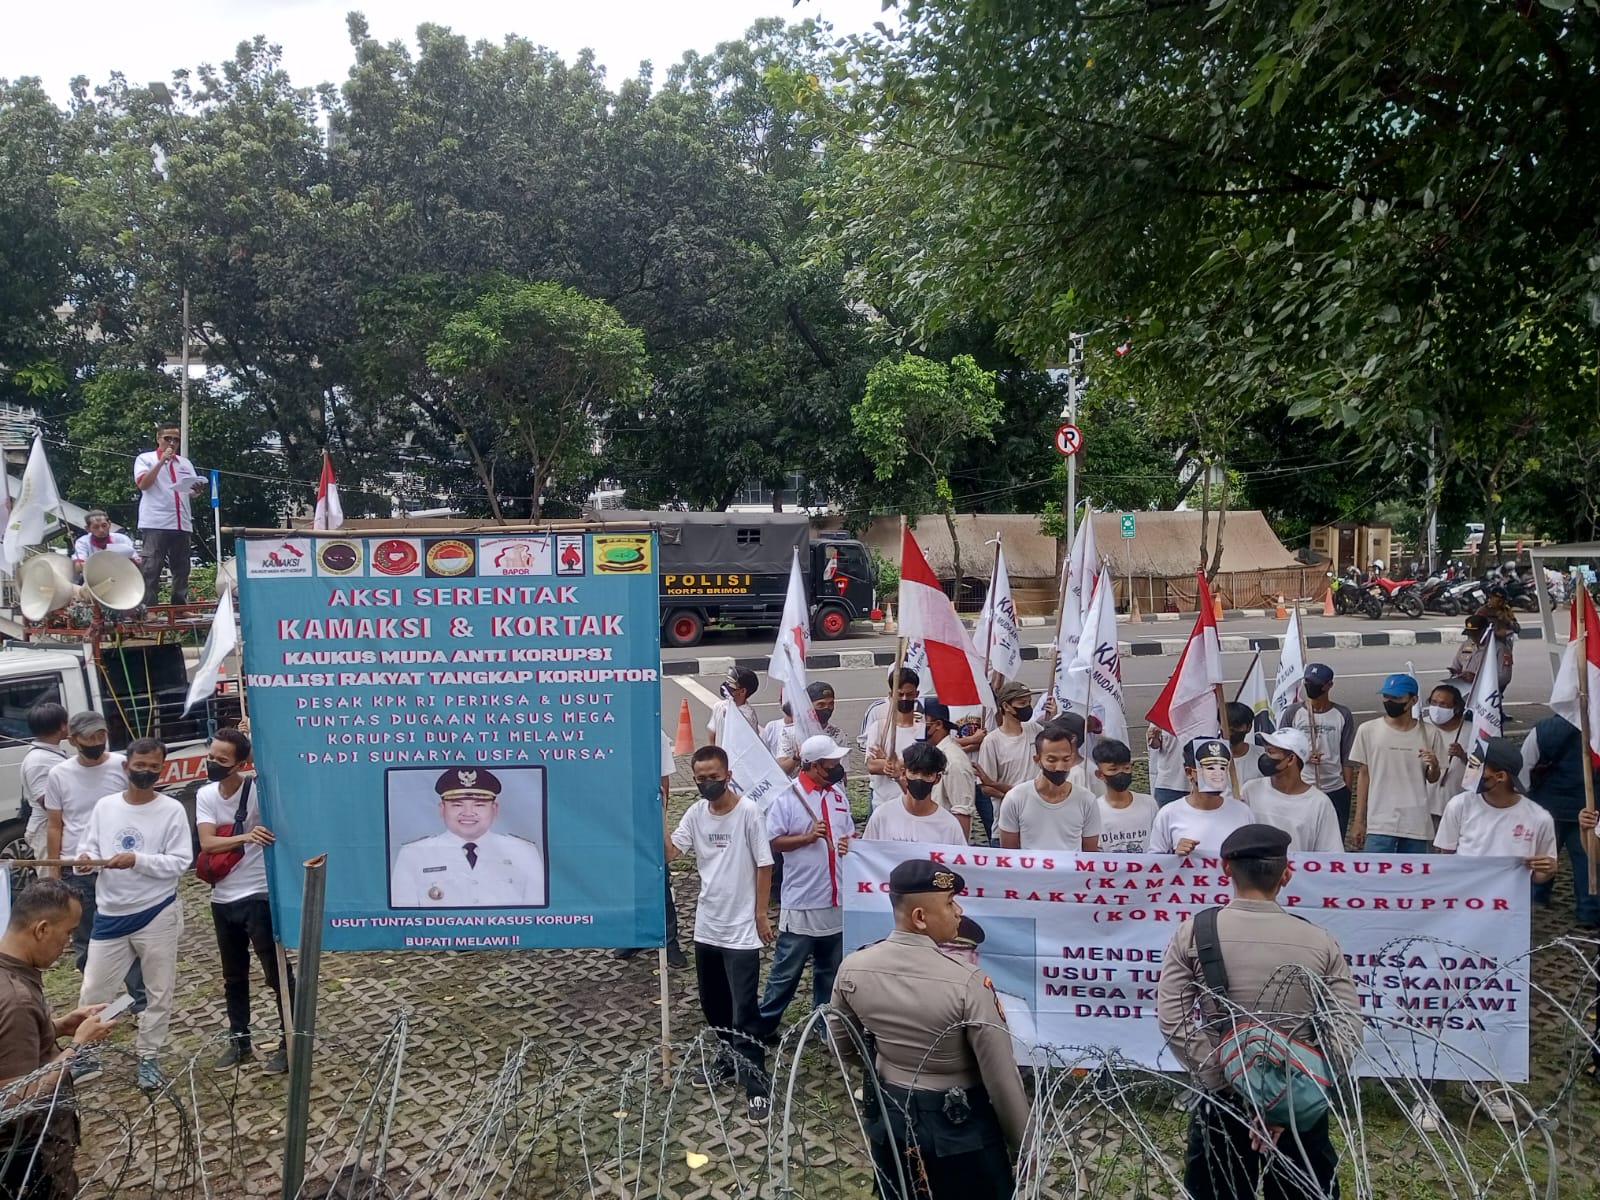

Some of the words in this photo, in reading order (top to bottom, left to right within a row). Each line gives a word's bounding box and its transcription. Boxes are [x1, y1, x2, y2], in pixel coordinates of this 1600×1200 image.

[1064, 431, 1075, 449] P
[665, 575, 750, 586] POLISI
[328, 588, 402, 607] AKSI
[414, 586, 580, 606] SERENTAK
[278, 617, 432, 640] KAMAKSI
[449, 616, 474, 638] &
[492, 615, 624, 638] KORTAK
[283, 651, 377, 666] KAUKUS
[378, 650, 448, 665] MUDA
[450, 649, 507, 663] ANTI
[510, 648, 613, 662] KORUPSI
[246, 673, 335, 688] KOALISI
[338, 672, 425, 686] RAKYAT
[427, 671, 533, 685] TANGKAP
[536, 669, 658, 683] KORUPTOR
[297, 695, 363, 709] DESAK
[372, 695, 407, 707] KPK
[416, 695, 436, 707] RI
[445, 694, 529, 706] PERIKSA
[540, 695, 551, 705] &
[560, 693, 614, 705] USUT
[296, 714, 380, 727] TUNTAS
[390, 712, 476, 725] DUGAAN
[485, 713, 553, 724] KASUS
[563, 711, 615, 724] MEGA
[327, 732, 415, 745] KORUPSI
[425, 731, 499, 743] BUPATI
[508, 730, 584, 743] MELAWI
[369, 750, 466, 763] SUNARYA
[476, 749, 529, 761] USFA
[1102, 830, 1147, 843] Djakarta
[929, 851, 1055, 870] KAUKUS
[1075, 860, 1163, 873] MUDA
[1180, 857, 1219, 869] AN
[1086, 875, 1231, 890] (KAMAKS
[857, 881, 985, 897] KOSI
[1004, 889, 1129, 905] RAKYAT
[1322, 897, 1509, 910] KORUPTOR
[330, 918, 367, 928] USUT
[370, 917, 422, 927] TUNTAS
[424, 916, 484, 926] DUGAAN
[487, 915, 533, 925] KASUS
[535, 914, 594, 924] KORUPSI
[1093, 909, 1192, 922] (KORT
[405, 936, 451, 947] BUPATI
[455, 936, 508, 946] MELAWI
[512, 935, 520, 945] !!
[1062, 946, 1162, 963] MENDE
[1344, 954, 1427, 969] RIKSA
[1440, 957, 1498, 970] DAN
[1042, 966, 1117, 982] USUT
[1383, 974, 1521, 992] SKANDAL
[1045, 983, 1126, 999] MEGA
[1398, 995, 1517, 1012] MELAWI
[1075, 1004, 1143, 1019] DADI
[1391, 1016, 1486, 1031] YURSA
